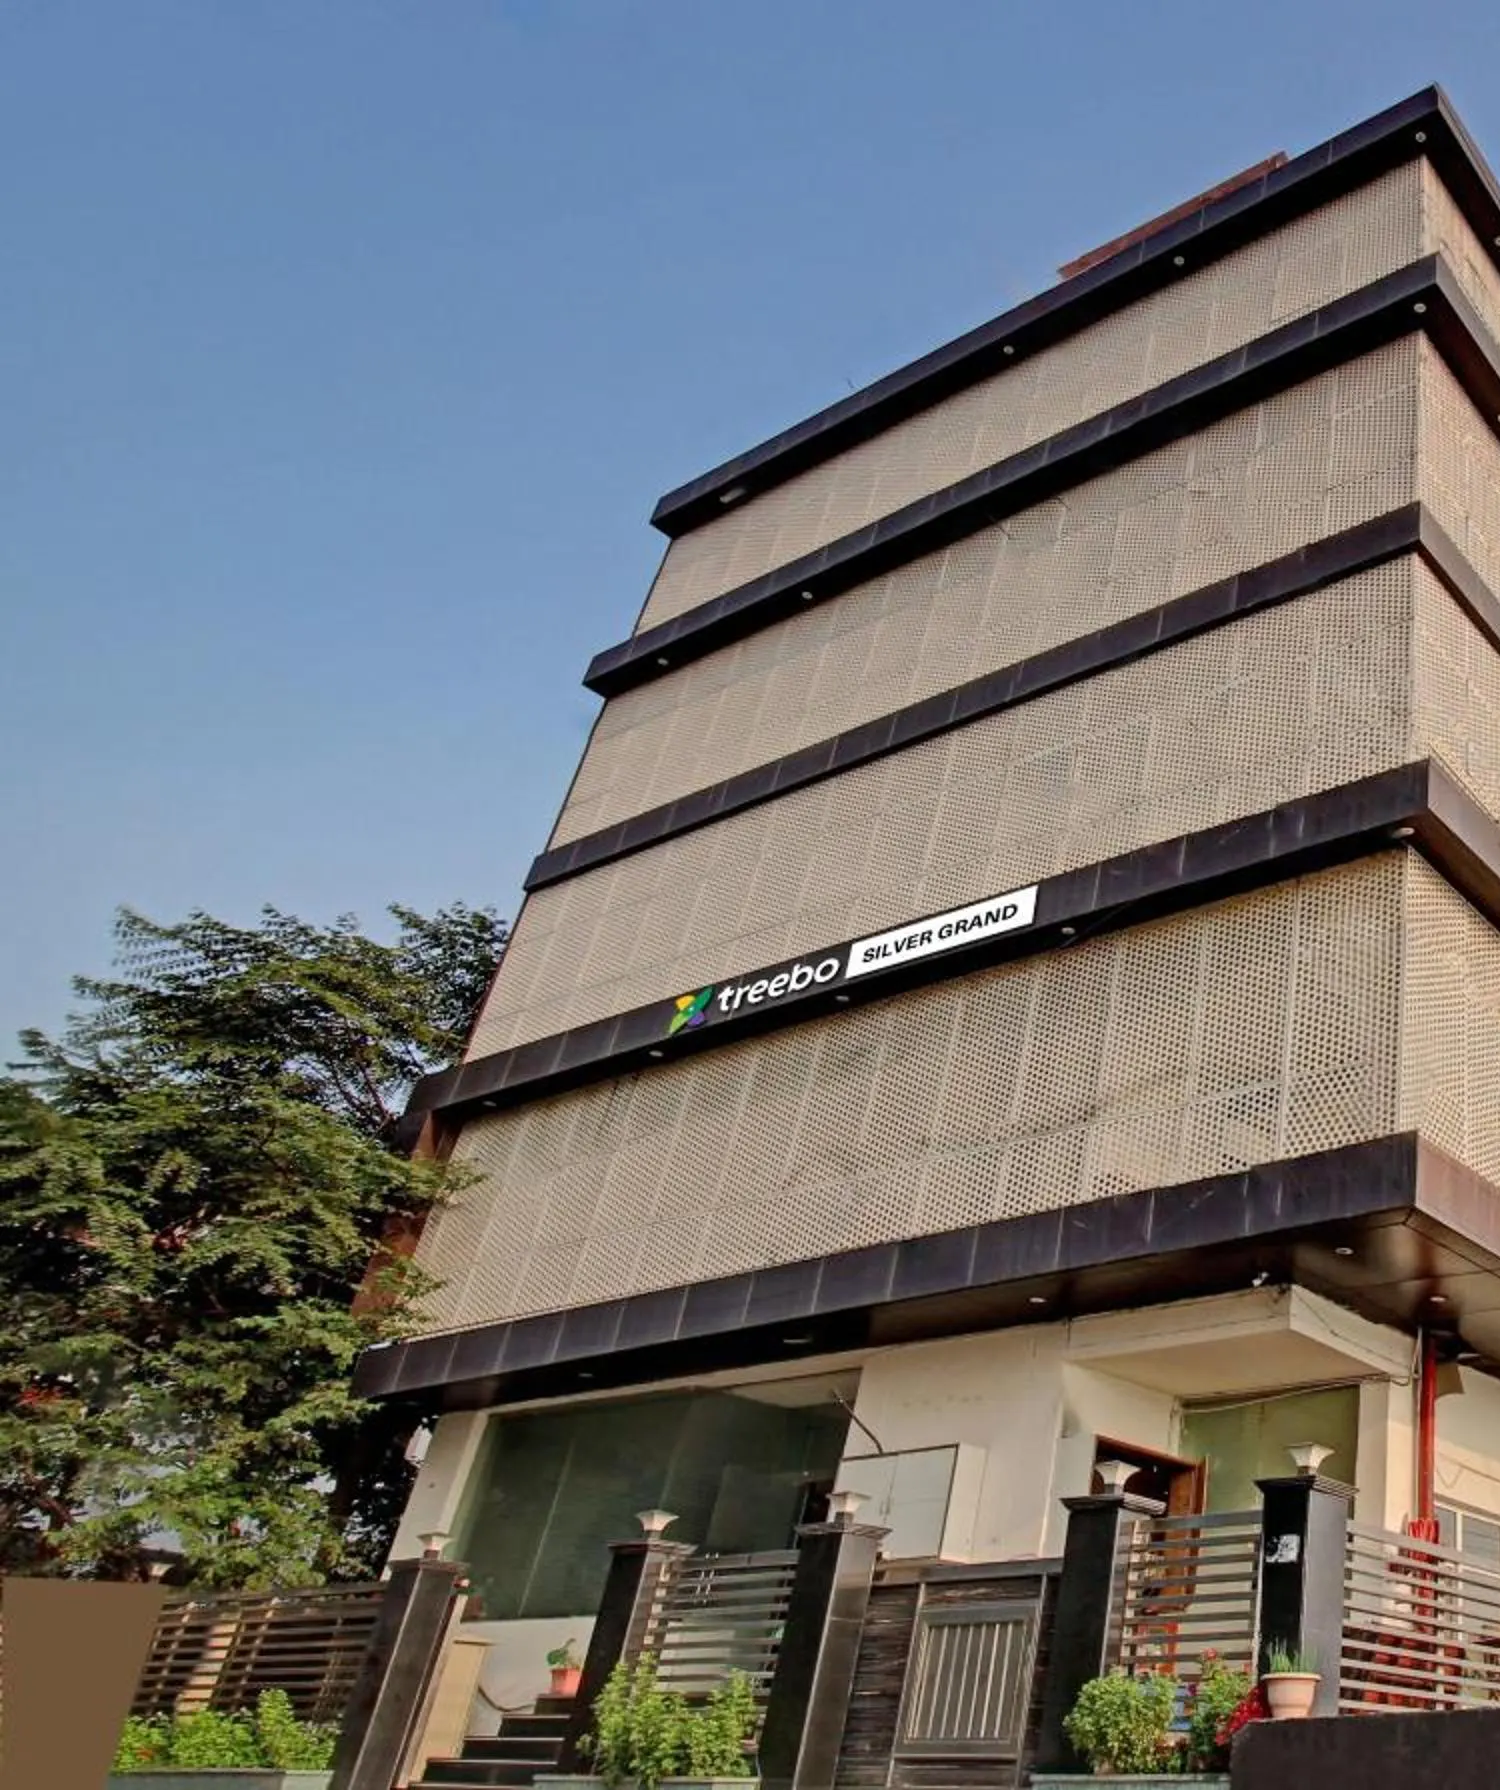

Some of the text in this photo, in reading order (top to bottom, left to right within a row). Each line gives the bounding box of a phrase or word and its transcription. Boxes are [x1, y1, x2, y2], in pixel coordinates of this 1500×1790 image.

[862, 903, 1018, 963] SILVER GRAND
[718, 958, 840, 1011] treebo
